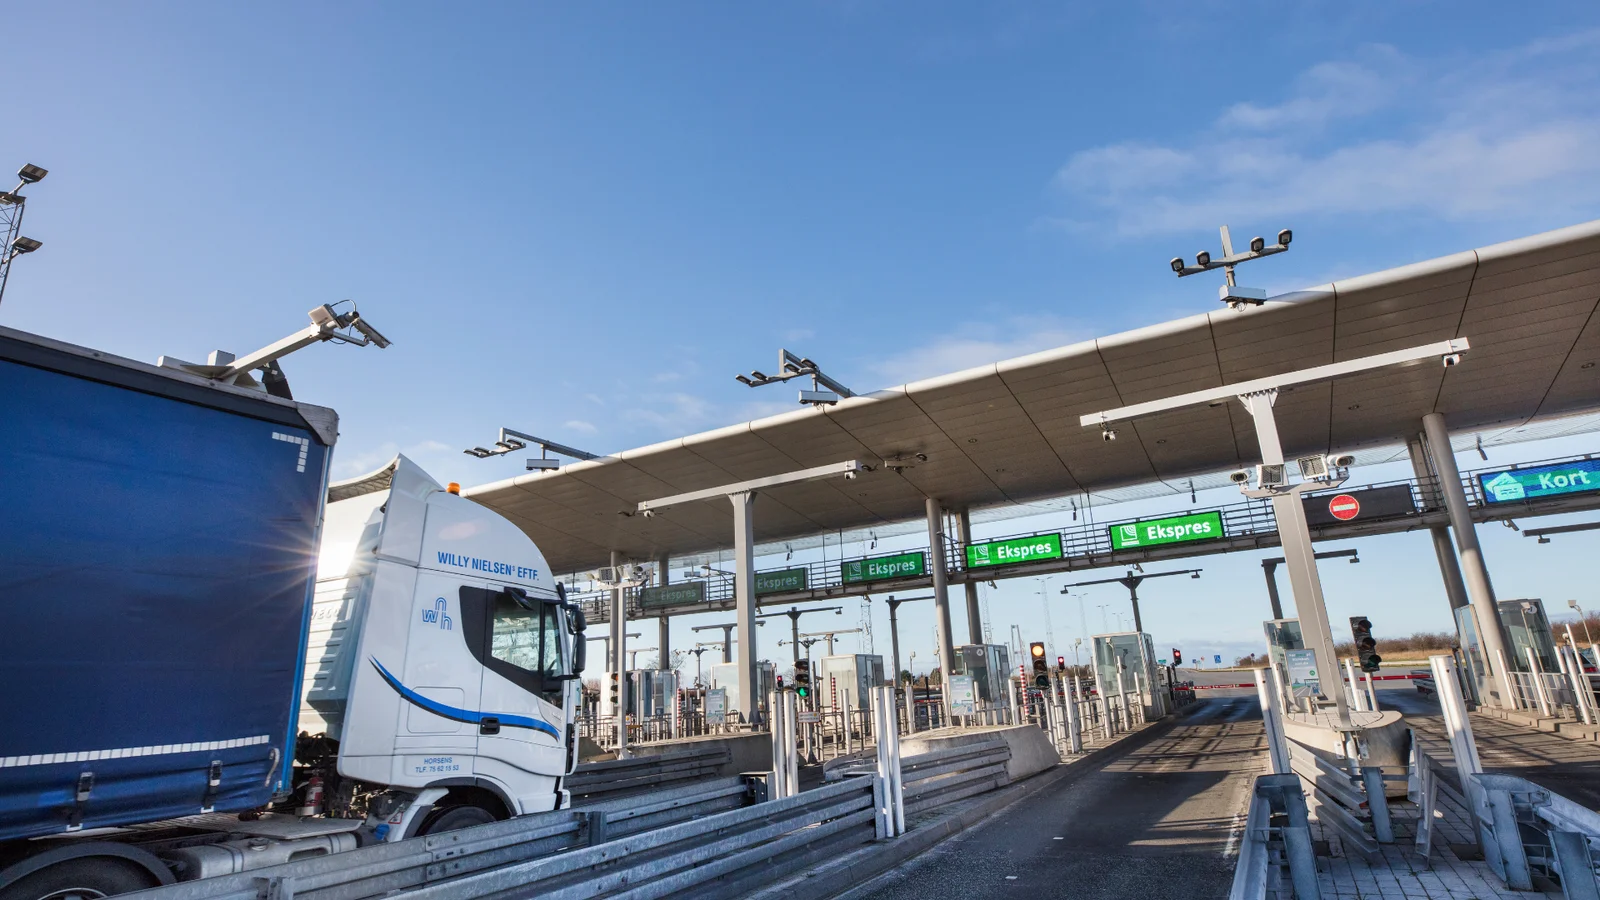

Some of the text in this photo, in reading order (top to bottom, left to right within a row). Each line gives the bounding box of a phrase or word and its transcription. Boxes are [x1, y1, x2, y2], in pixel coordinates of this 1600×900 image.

[1538, 469, 1591, 489] Kort
[1147, 521, 1211, 540] Ekspres
[997, 542, 1052, 559] Ekspres
[437, 551, 469, 568] WILLY
[517, 566, 539, 581] EFTF.
[868, 561, 916, 576] Ekspres
[757, 576, 798, 590] Ekspres
[661, 589, 697, 601] Ekspres
